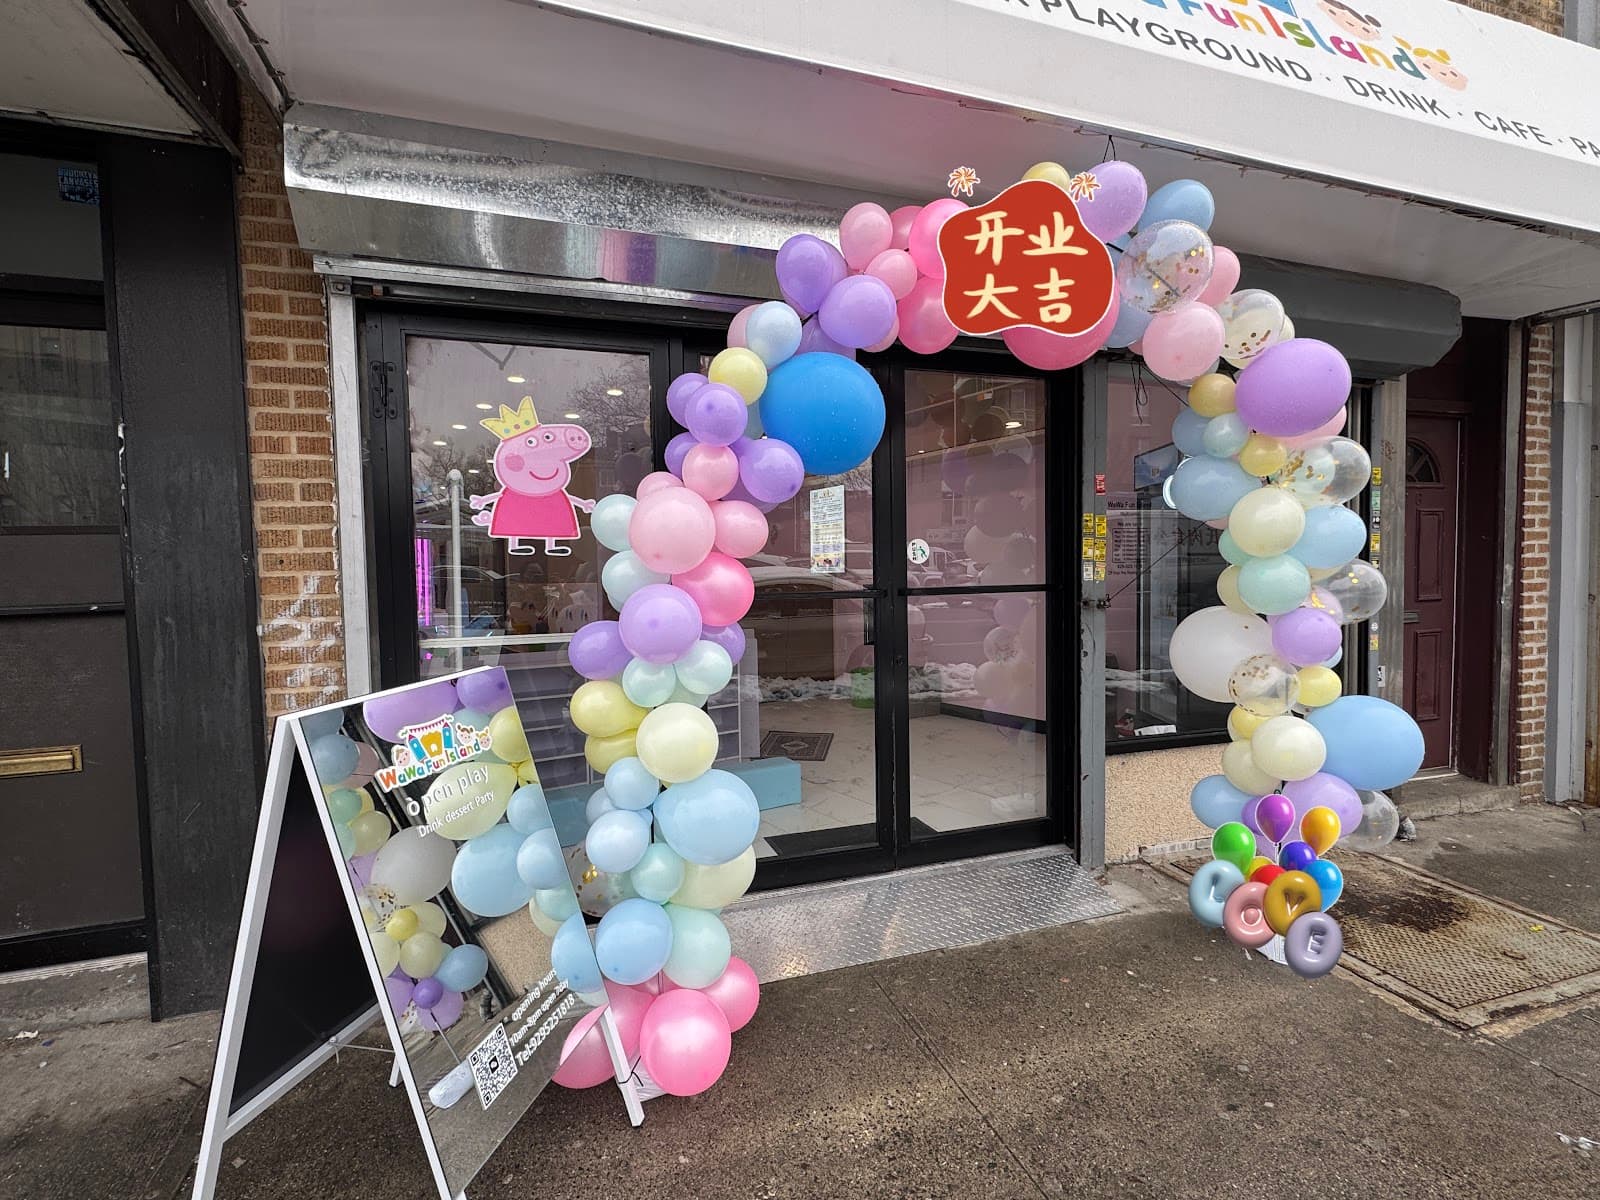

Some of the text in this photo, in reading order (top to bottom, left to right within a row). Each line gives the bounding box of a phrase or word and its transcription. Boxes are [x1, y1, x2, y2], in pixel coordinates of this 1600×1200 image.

[1342, 74, 1451, 120] DRINK
[1473, 110, 1553, 146] CAFE
[456, 764, 490, 796] play
[418, 790, 496, 838] Drink dessert Party
[511, 967, 558, 1021] opening hours
[540, 991, 557, 1013] open
